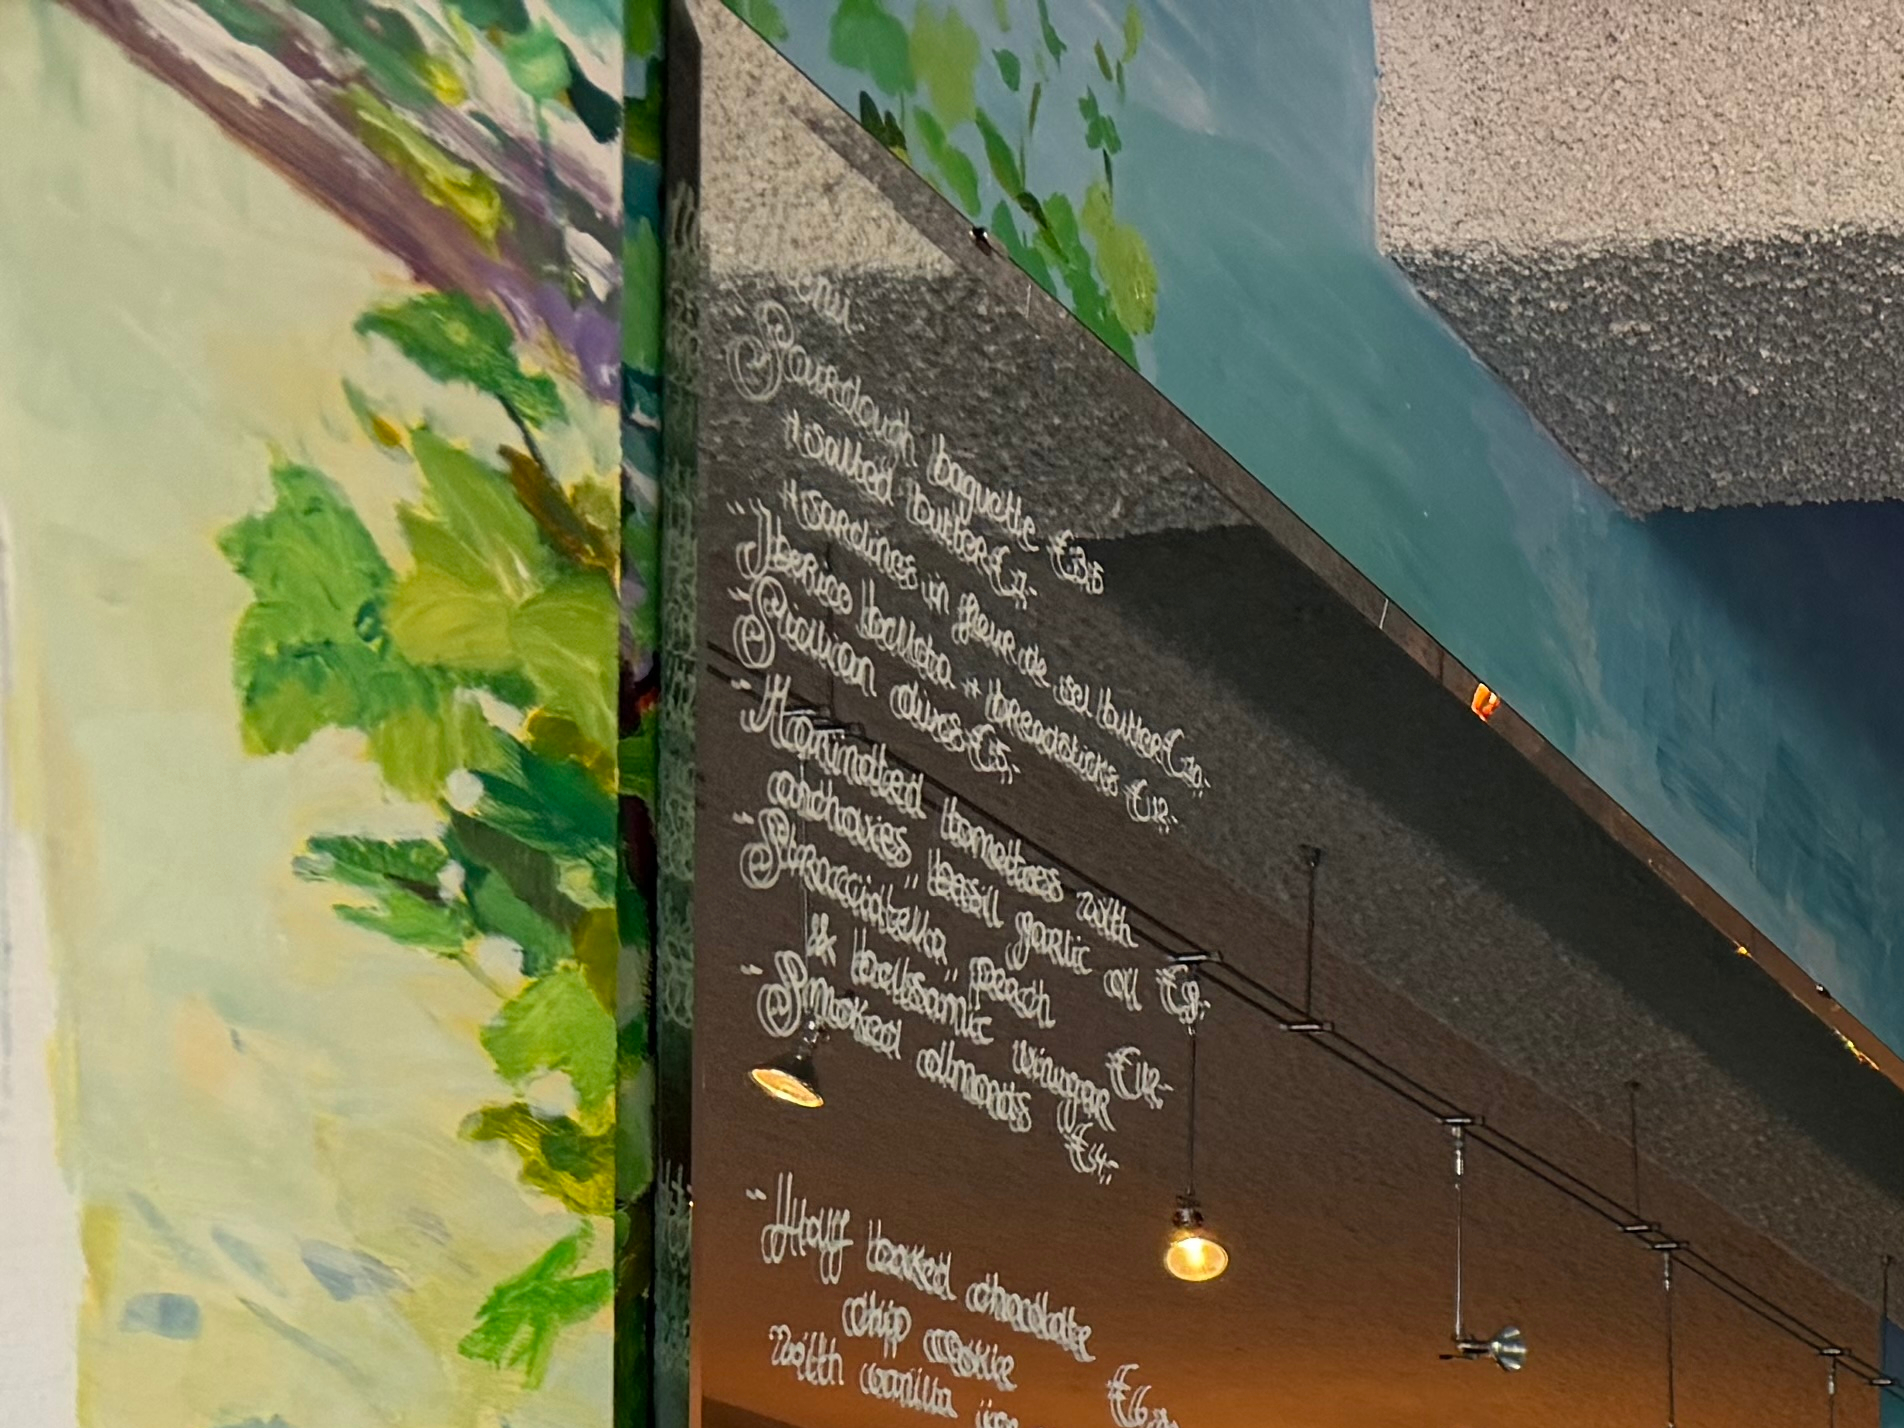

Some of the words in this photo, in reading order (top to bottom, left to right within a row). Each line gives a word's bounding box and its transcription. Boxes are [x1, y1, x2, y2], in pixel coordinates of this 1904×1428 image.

[926, 432, 1040, 552] baguette
[921, 571, 949, 615] in
[1005, 911, 1093, 975] garlic
[1076, 891, 1138, 948] with
[841, 1290, 912, 1359] chip
